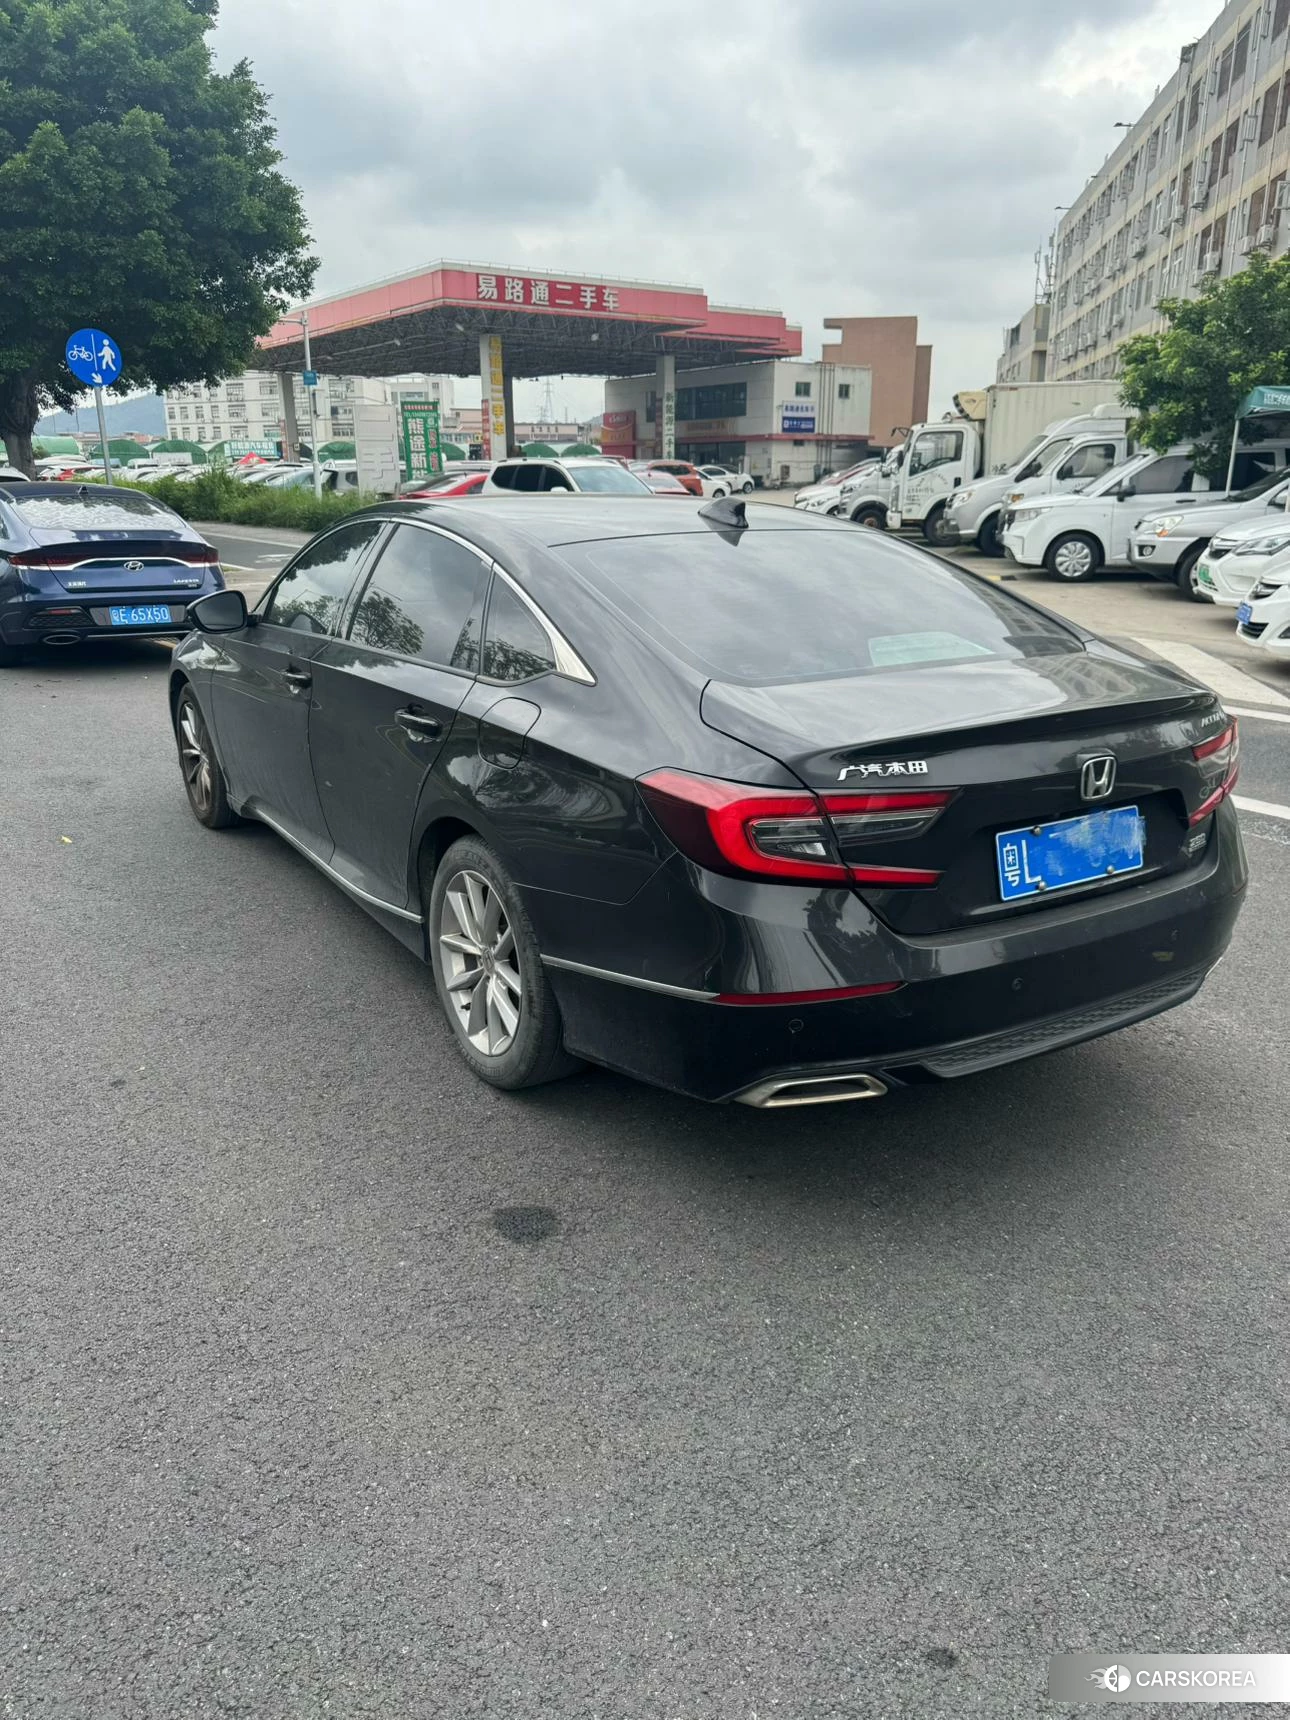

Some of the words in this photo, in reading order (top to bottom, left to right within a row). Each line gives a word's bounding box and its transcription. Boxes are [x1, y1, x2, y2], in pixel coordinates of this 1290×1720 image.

[478, 274, 619, 311] 易路通二手车
[837, 761, 928, 781] 广汽本田
